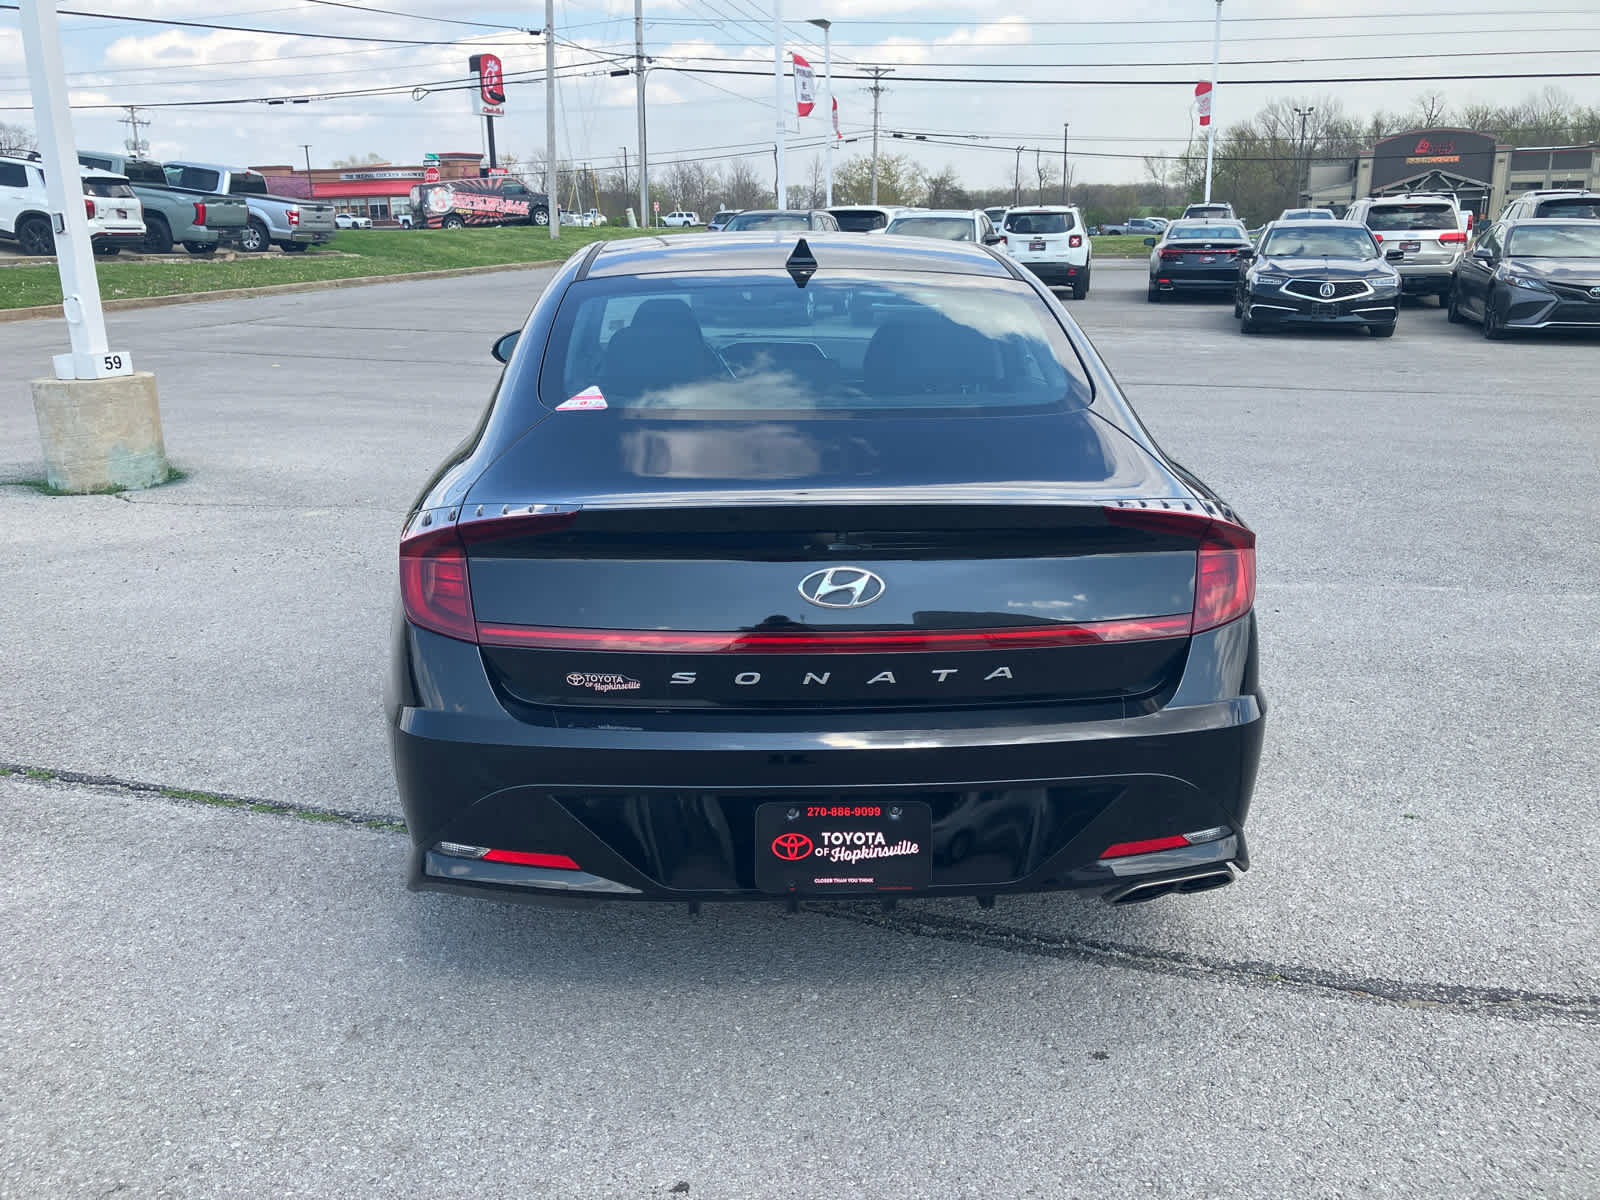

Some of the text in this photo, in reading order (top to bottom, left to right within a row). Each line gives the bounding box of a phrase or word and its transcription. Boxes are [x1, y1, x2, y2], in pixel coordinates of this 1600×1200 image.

[425, 173, 440, 181] STOP
[104, 355, 122, 370] 59
[585, 674, 624, 683] TOYOTA
[670, 666, 1013, 685] SONATA
[594, 682, 640, 692] Hopkinsville
[807, 806, 881, 817] 270-886-9099
[821, 832, 886, 845] TOYOTA
[814, 840, 919, 864] OF Hopkinsville
